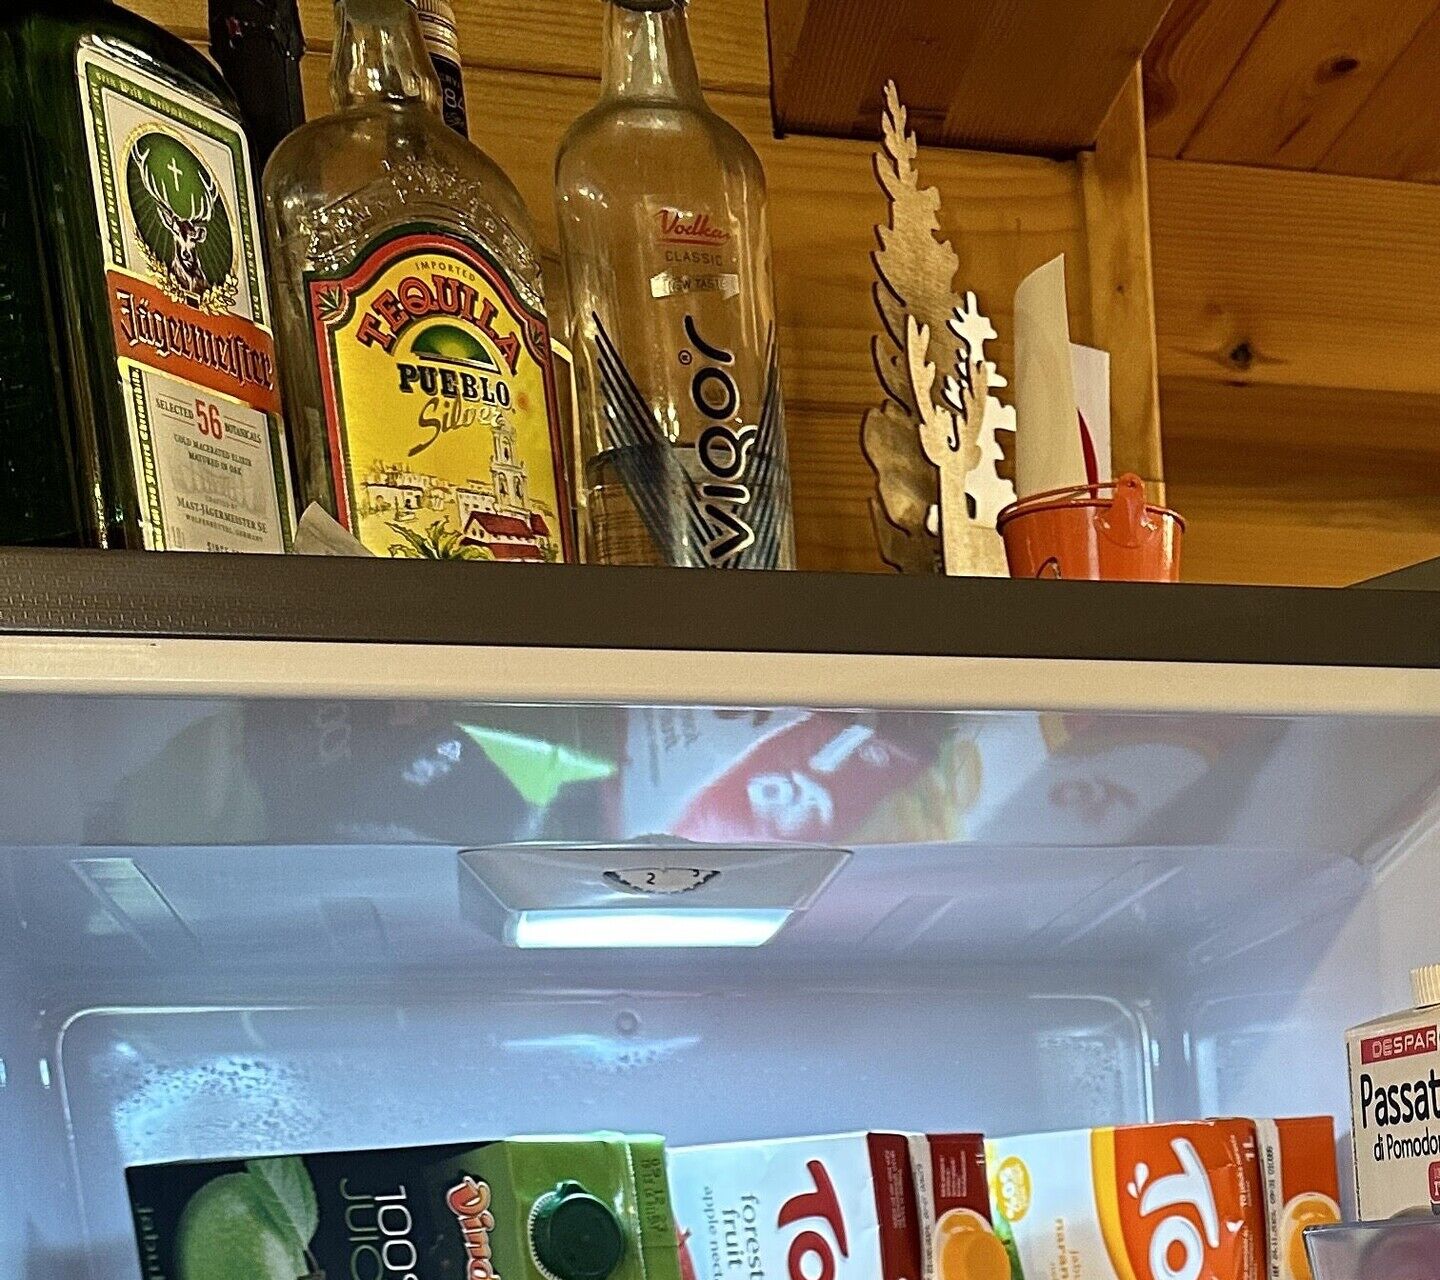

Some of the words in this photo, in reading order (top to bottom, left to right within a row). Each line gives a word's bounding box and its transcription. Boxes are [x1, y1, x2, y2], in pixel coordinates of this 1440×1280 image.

[657, 207, 731, 241] Vodka
[415, 260, 476, 282] IMPORTED
[665, 249, 724, 268] CLASSIC
[356, 273, 521, 375] TEQUILA
[397, 363, 511, 408] PUEBLO
[155, 397, 194, 420] SELECTED
[195, 398, 223, 440] 56
[224, 421, 262, 445] BOTANICALS
[408, 396, 506, 457] Silver
[1371, 1029, 1437, 1059] DESPAR
[1373, 1133, 1385, 1162] di
[702, 1186, 719, 1235] apple
[722, 1209, 745, 1268] fruit
[740, 1195, 765, 1280] forest
